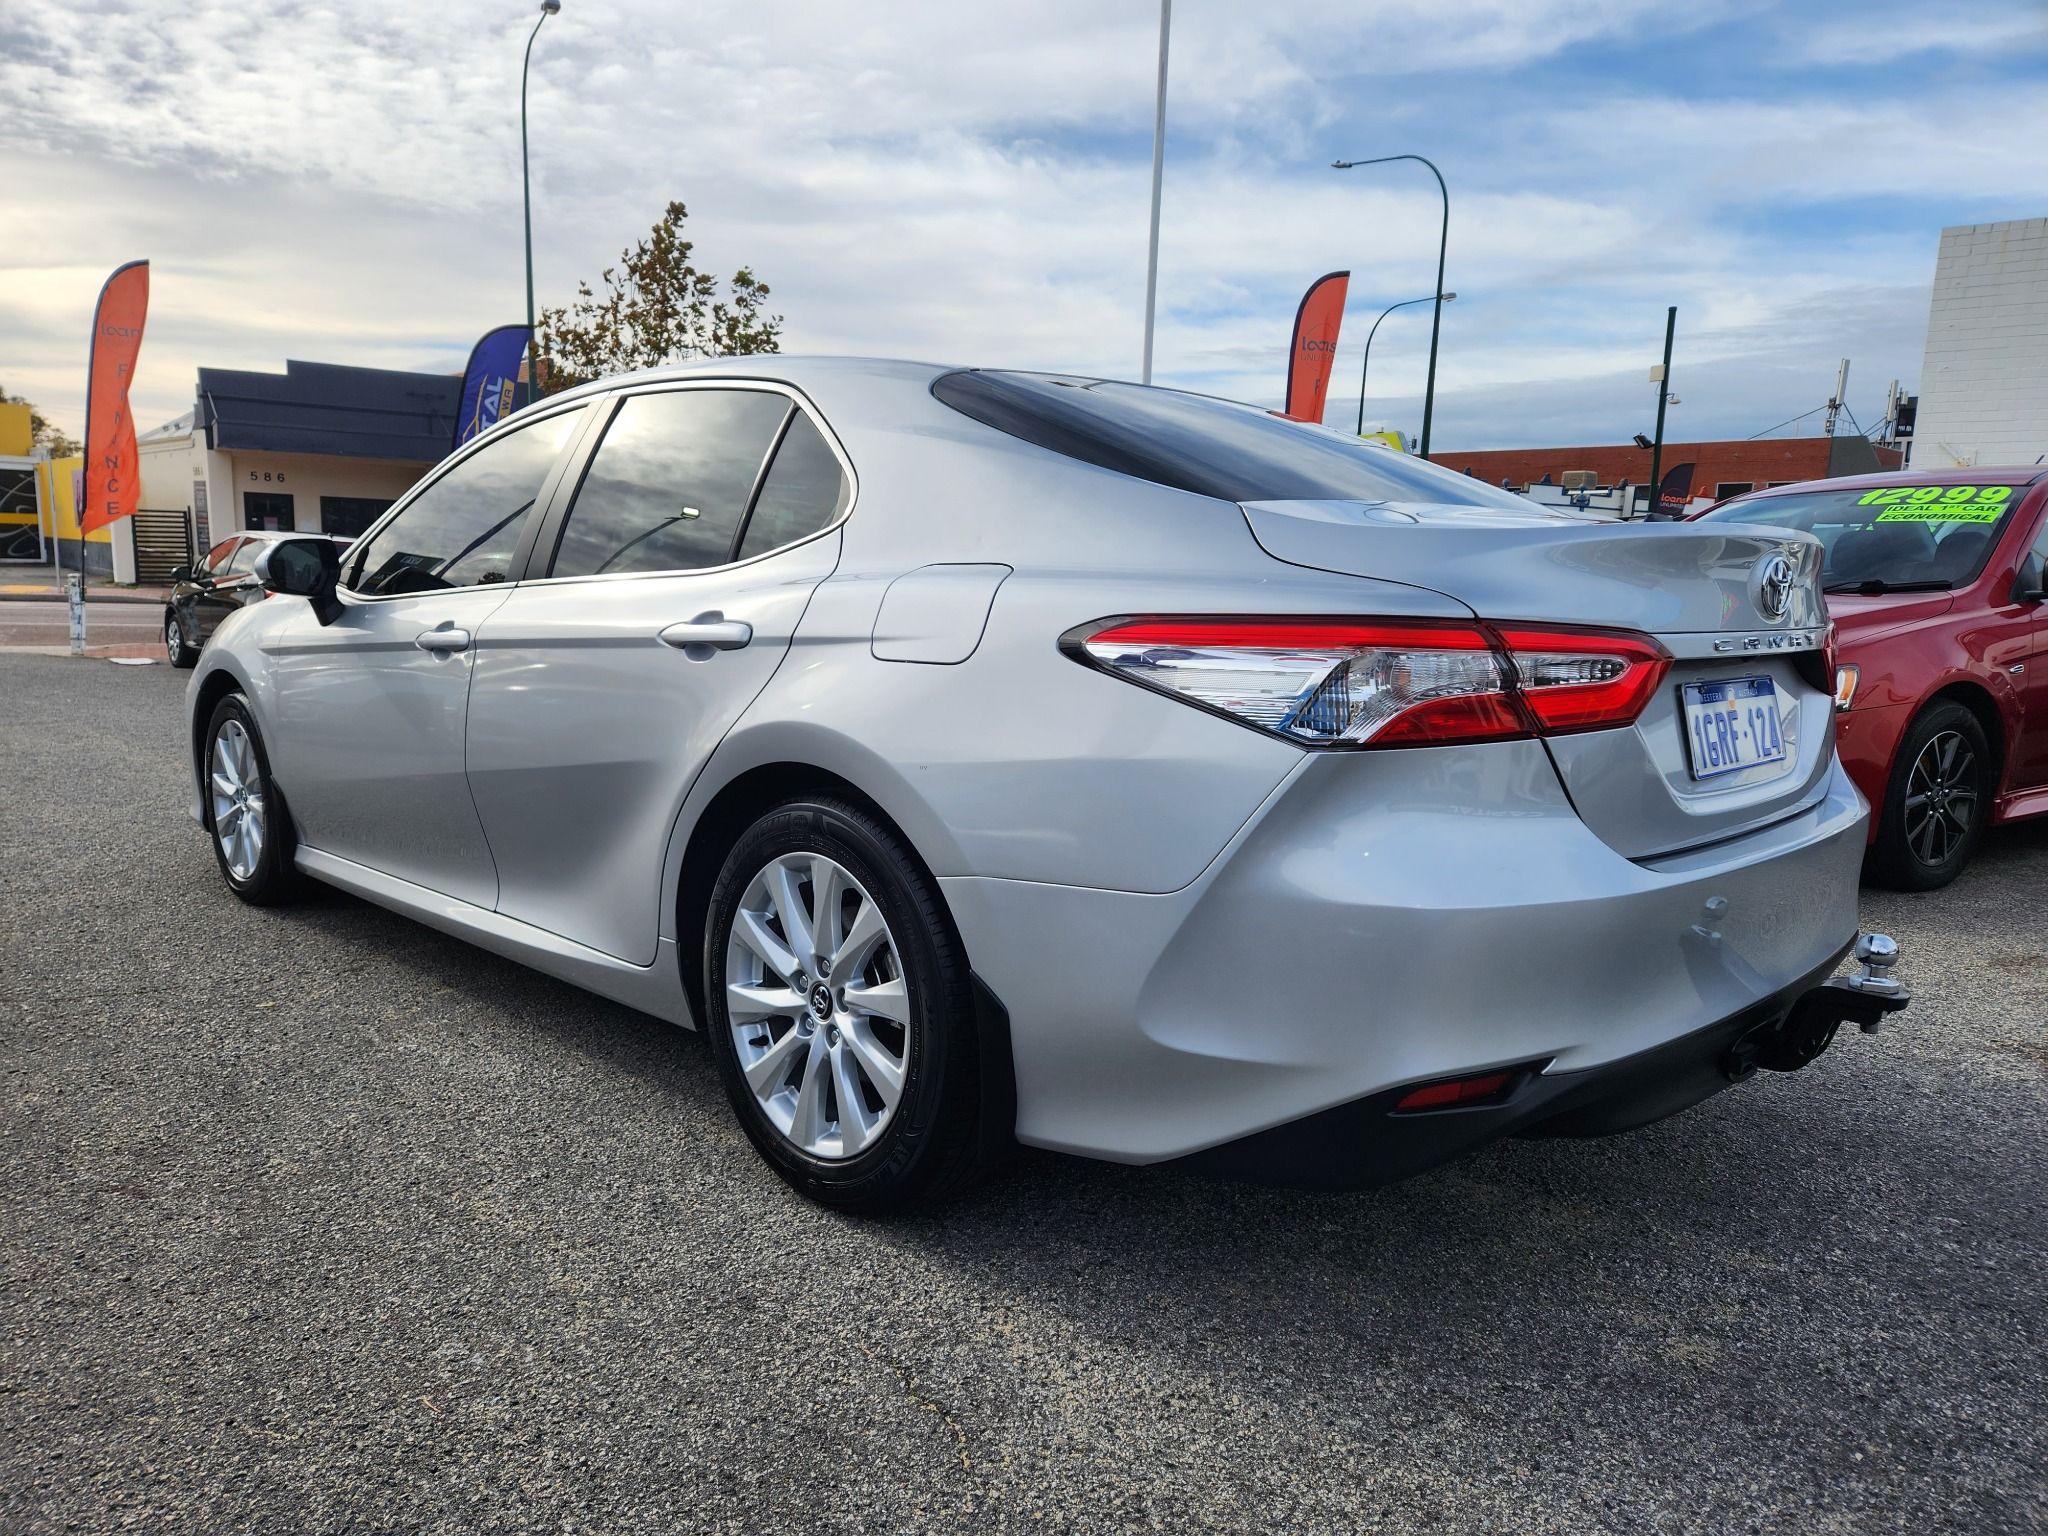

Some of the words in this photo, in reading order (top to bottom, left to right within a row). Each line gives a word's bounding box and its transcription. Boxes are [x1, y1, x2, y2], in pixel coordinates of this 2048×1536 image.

[250, 471, 285, 482] 586
[1857, 486, 2013, 505] 12999
[1888, 504, 1934, 512] IDEAL
[1962, 504, 1999, 512] CAR
[1881, 512, 1992, 521] ECONOMICAL
